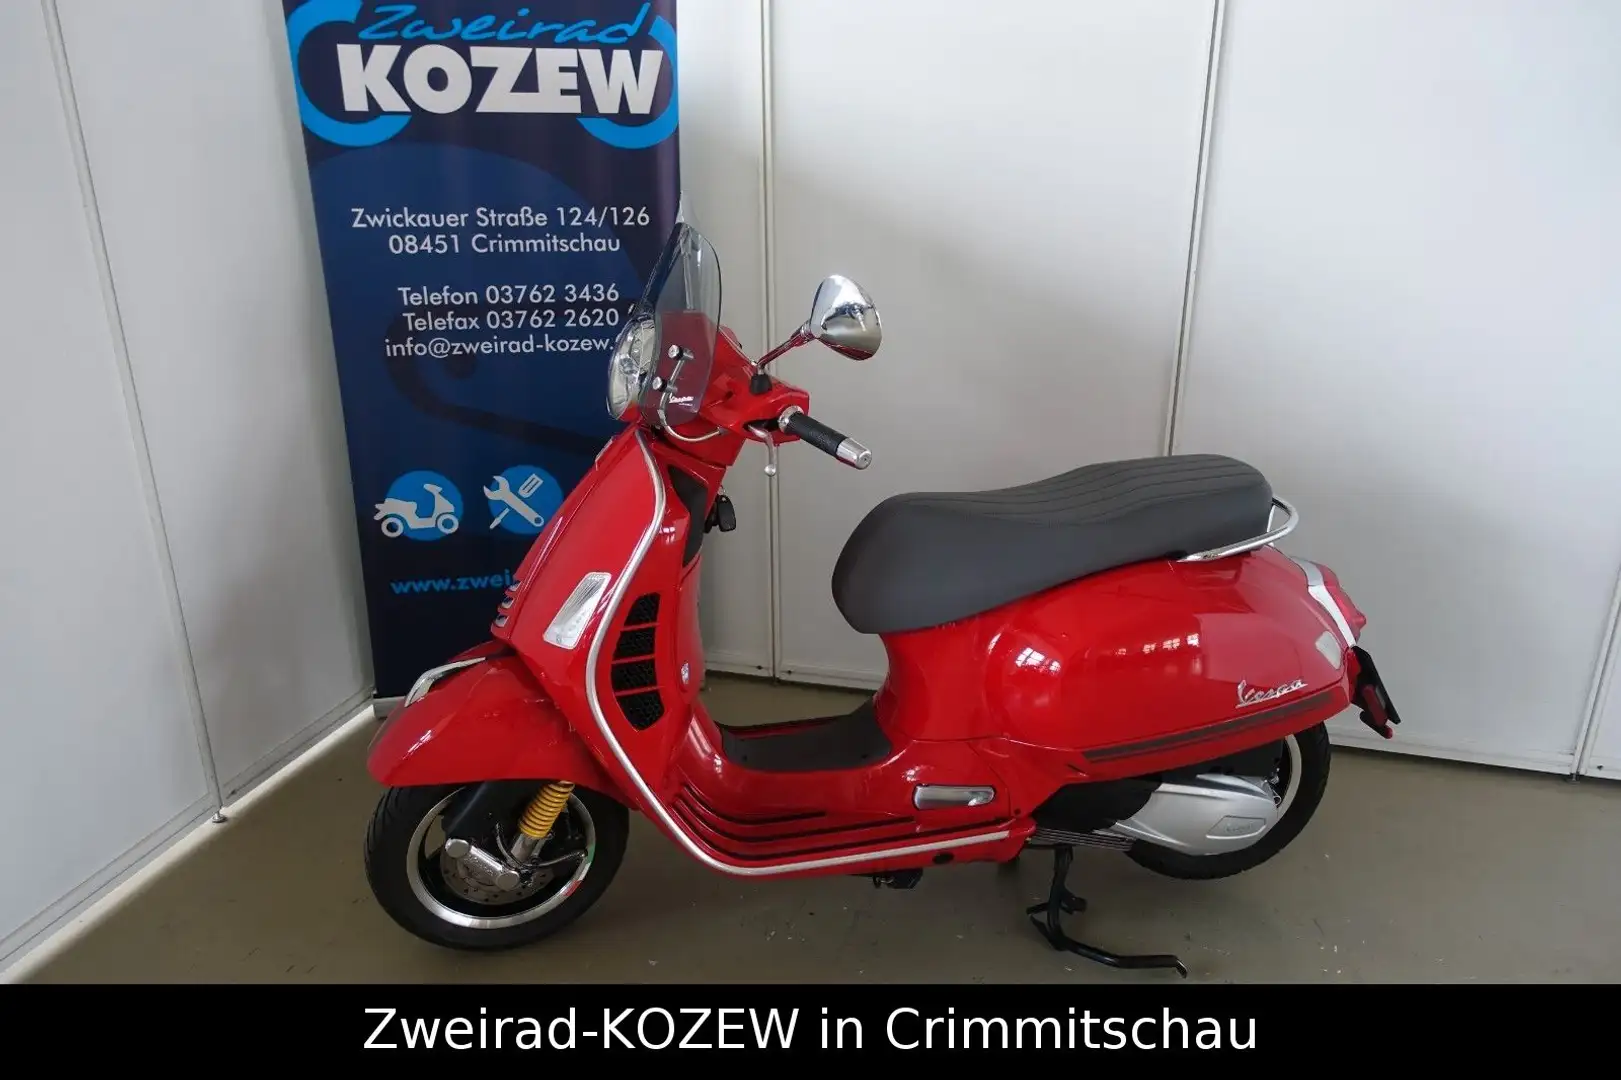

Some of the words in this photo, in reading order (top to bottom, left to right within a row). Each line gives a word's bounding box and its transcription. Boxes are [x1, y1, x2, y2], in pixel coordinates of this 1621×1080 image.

[357, 2, 652, 44] Zweirad
[336, 43, 664, 114] KOZEW
[351, 207, 468, 228] Zwickauer
[476, 206, 548, 227] Straße
[557, 206, 650, 227] 124/126
[388, 234, 459, 255] 08451
[471, 232, 620, 253] Crimmitschau
[398, 286, 478, 306] Telefon
[486, 284, 556, 304] 03762
[564, 283, 619, 303] 3436
[402, 310, 480, 331] Telefax
[486, 309, 556, 329] 03762
[564, 308, 619, 328] 2620
[385, 334, 619, 359] info@zweirad-kozew.
[1235, 679, 1308, 709] Vespa
